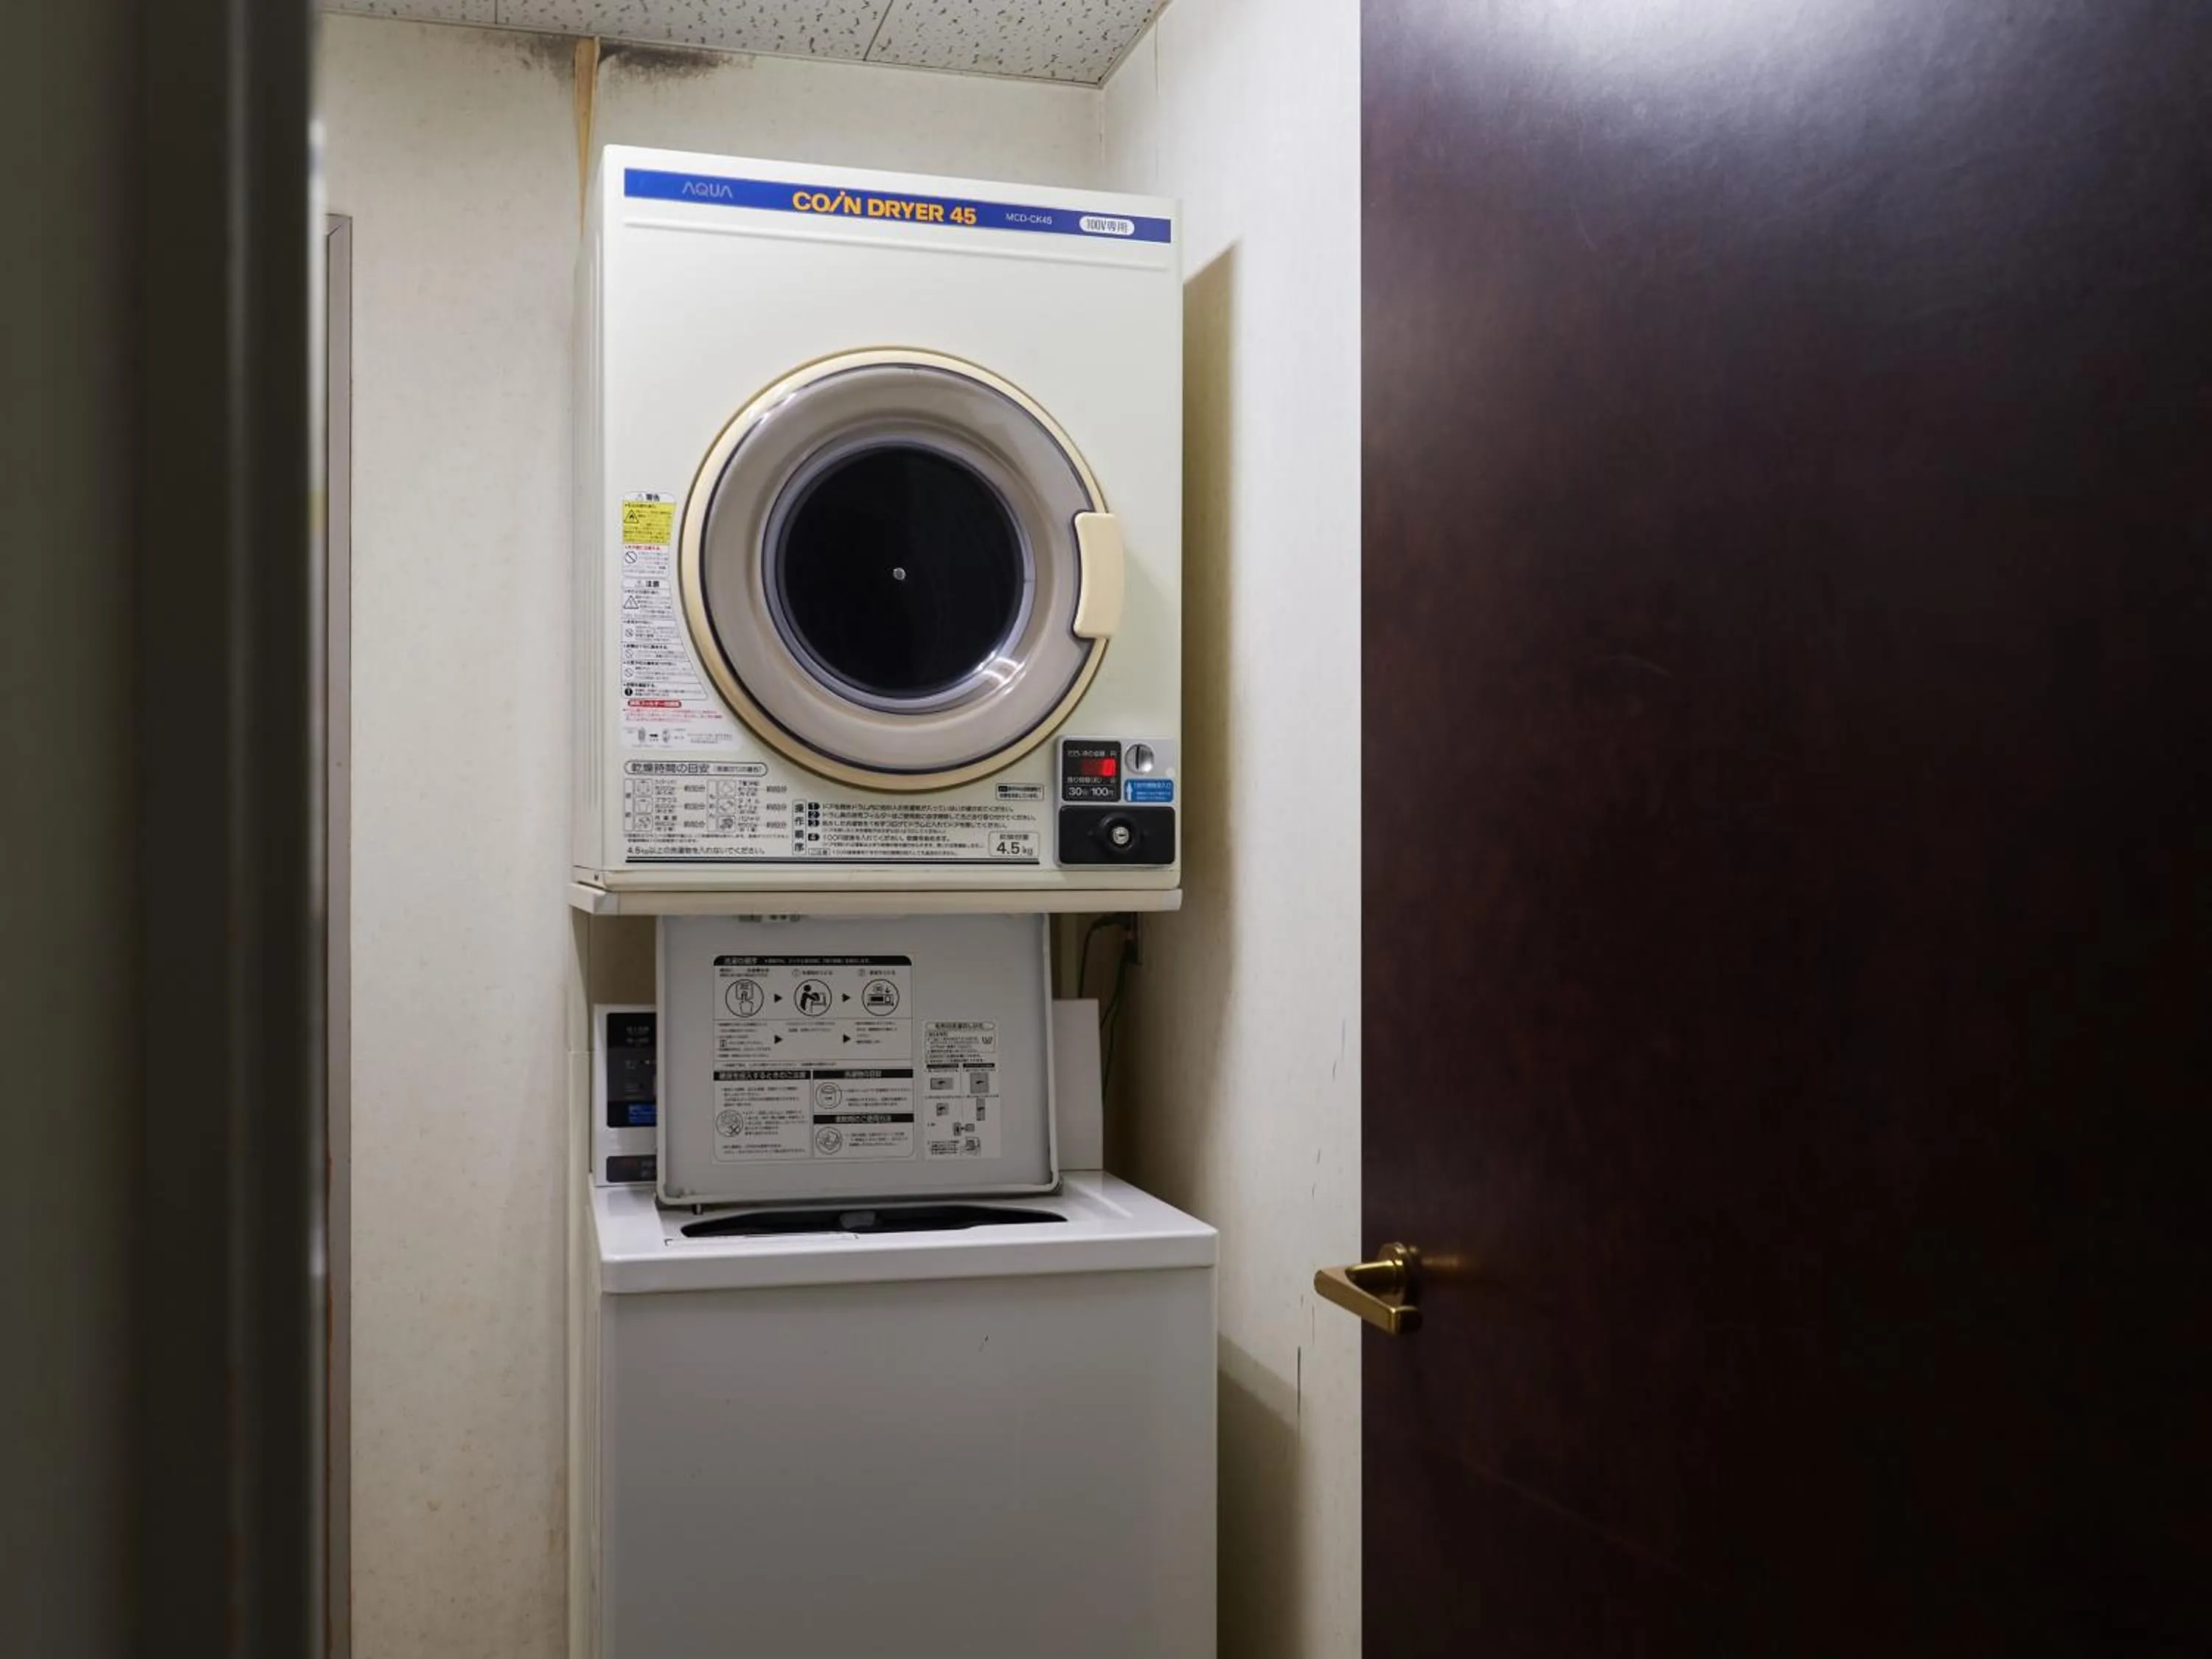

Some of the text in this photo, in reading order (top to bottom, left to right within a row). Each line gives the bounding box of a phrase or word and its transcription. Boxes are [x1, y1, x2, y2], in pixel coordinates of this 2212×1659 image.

[682, 181, 733, 198] AQUA
[867, 198, 944, 222] DRYER
[950, 206, 977, 225] 45
